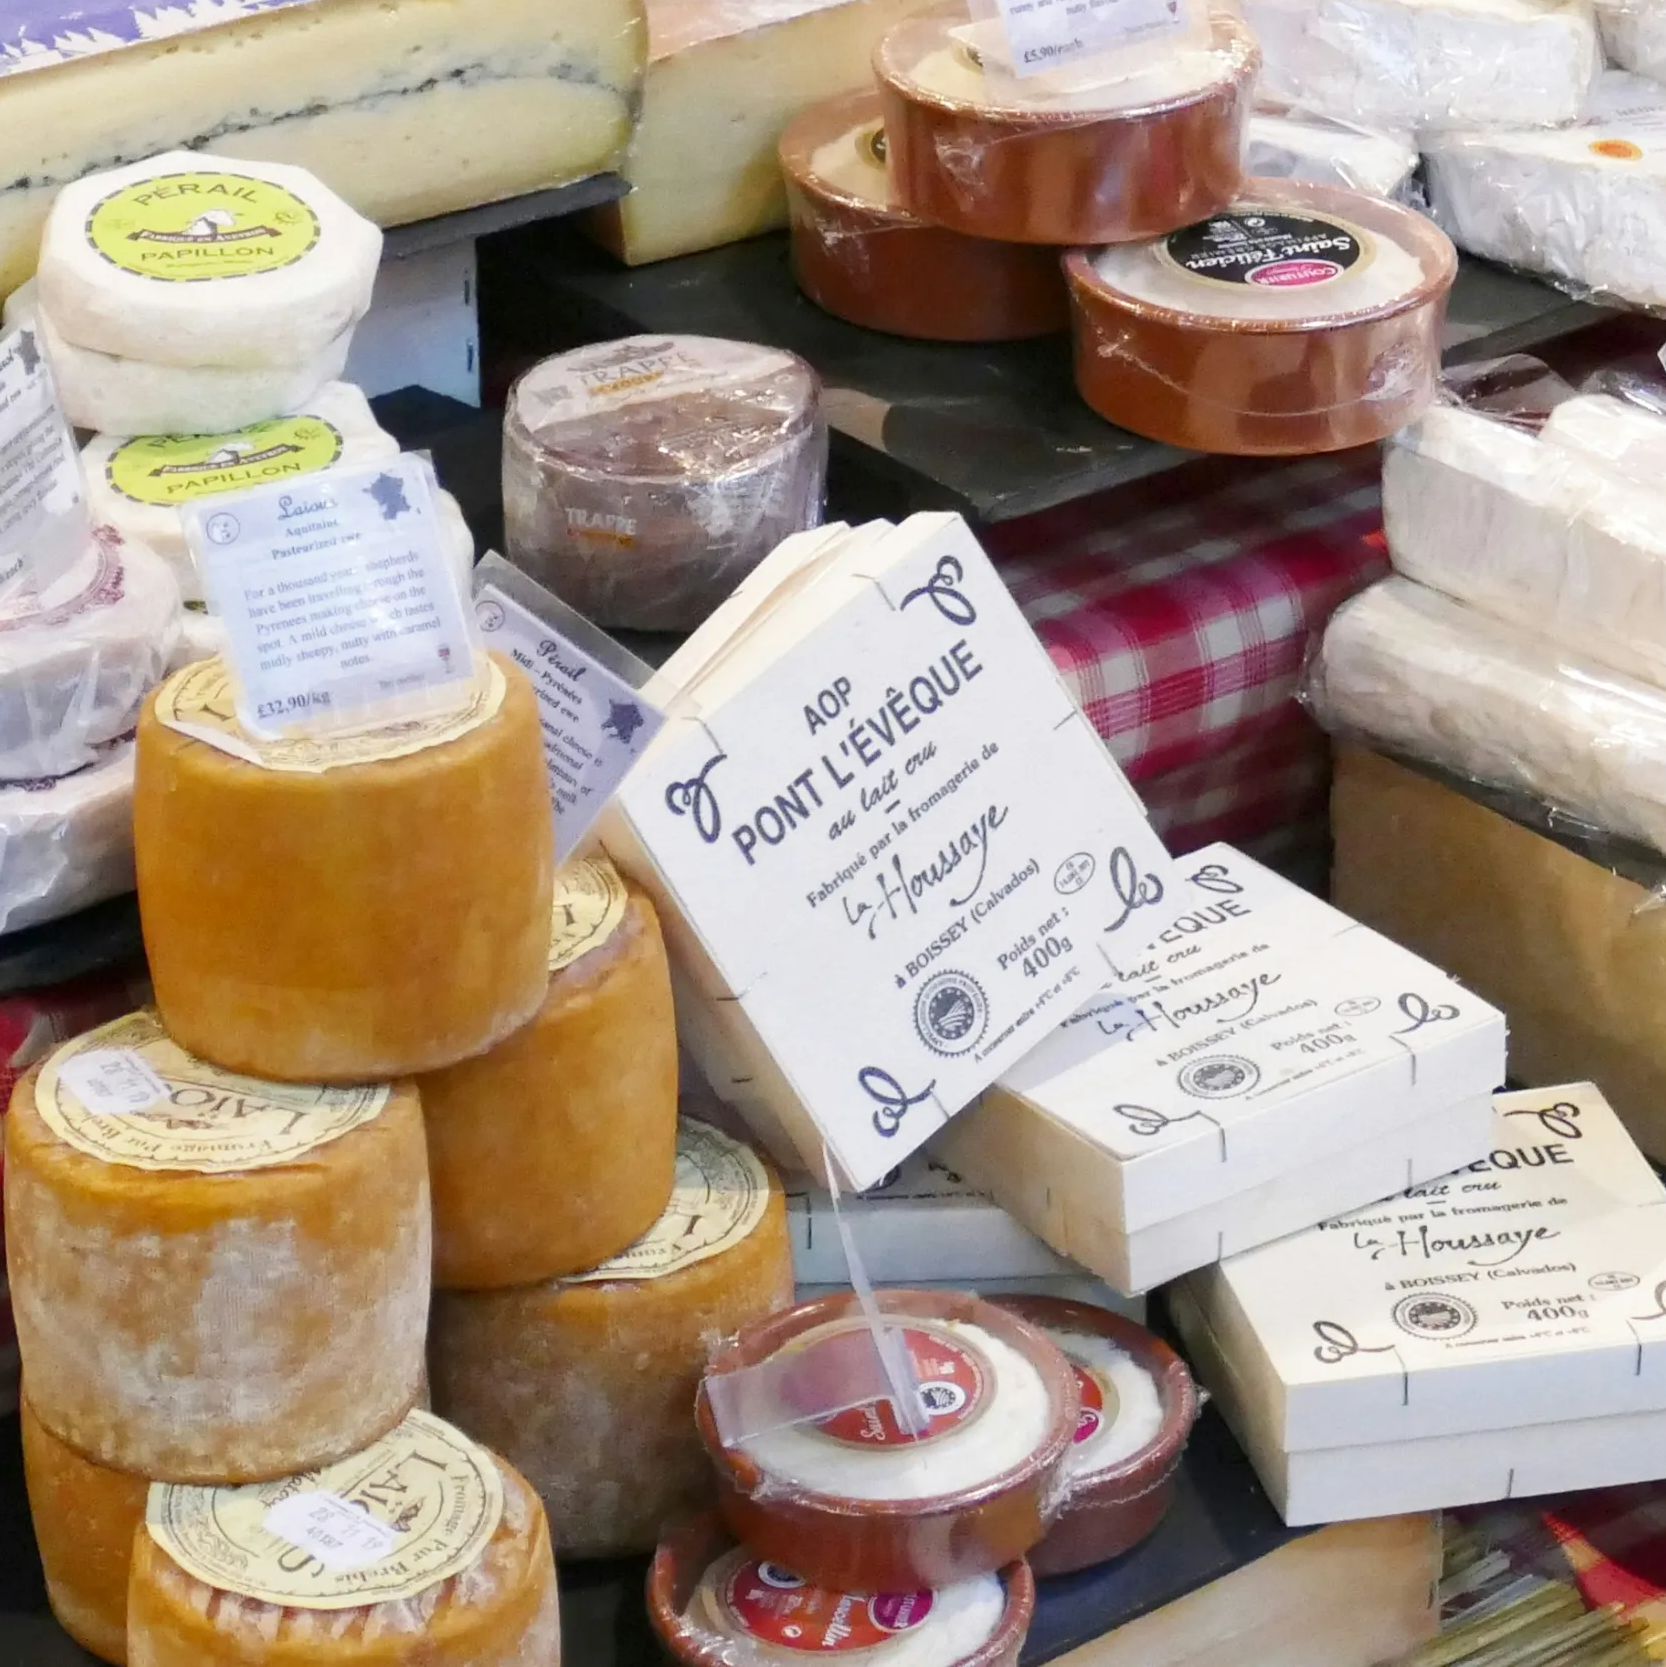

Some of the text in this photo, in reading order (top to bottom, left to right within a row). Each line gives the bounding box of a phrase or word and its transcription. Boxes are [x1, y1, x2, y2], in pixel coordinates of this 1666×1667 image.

[133, 182, 259, 207] PÉRAIL
[141, 246, 275, 263] PAPILLON
[167, 462, 301, 495] PAPILLON
[271, 536, 337, 561] Pasteurized
[803, 676, 854, 736] AOP
[729, 639, 985, 866] PONT L'ÉVÊQUE
[827, 740, 939, 841] au lait cru
[805, 741, 1000, 909] Fabriqué par la fromagerie de
[868, 805, 1010, 940] Houssaye
[905, 916, 970, 980] BOISSEY
[970, 858, 1041, 924] (Calvados)
[996, 912, 1062, 972] Poids net
[1020, 935, 1075, 980] 400g
[1125, 972, 1283, 1042] Houssaye
[1167, 998, 1319, 1062] BOISSEY (Calvados)
[1300, 1033, 1357, 1056] 400g
[1398, 1212, 1425, 1225] par
[1430, 1208, 1447, 1218] la
[1451, 1197, 1544, 1217] fromagerie
[1547, 1195, 1569, 1207] de
[1370, 1224, 1562, 1267] Houssaye
[1399, 1262, 1578, 1291] BOISSEY (Calvados)
[1526, 1306, 1591, 1322] 400g
